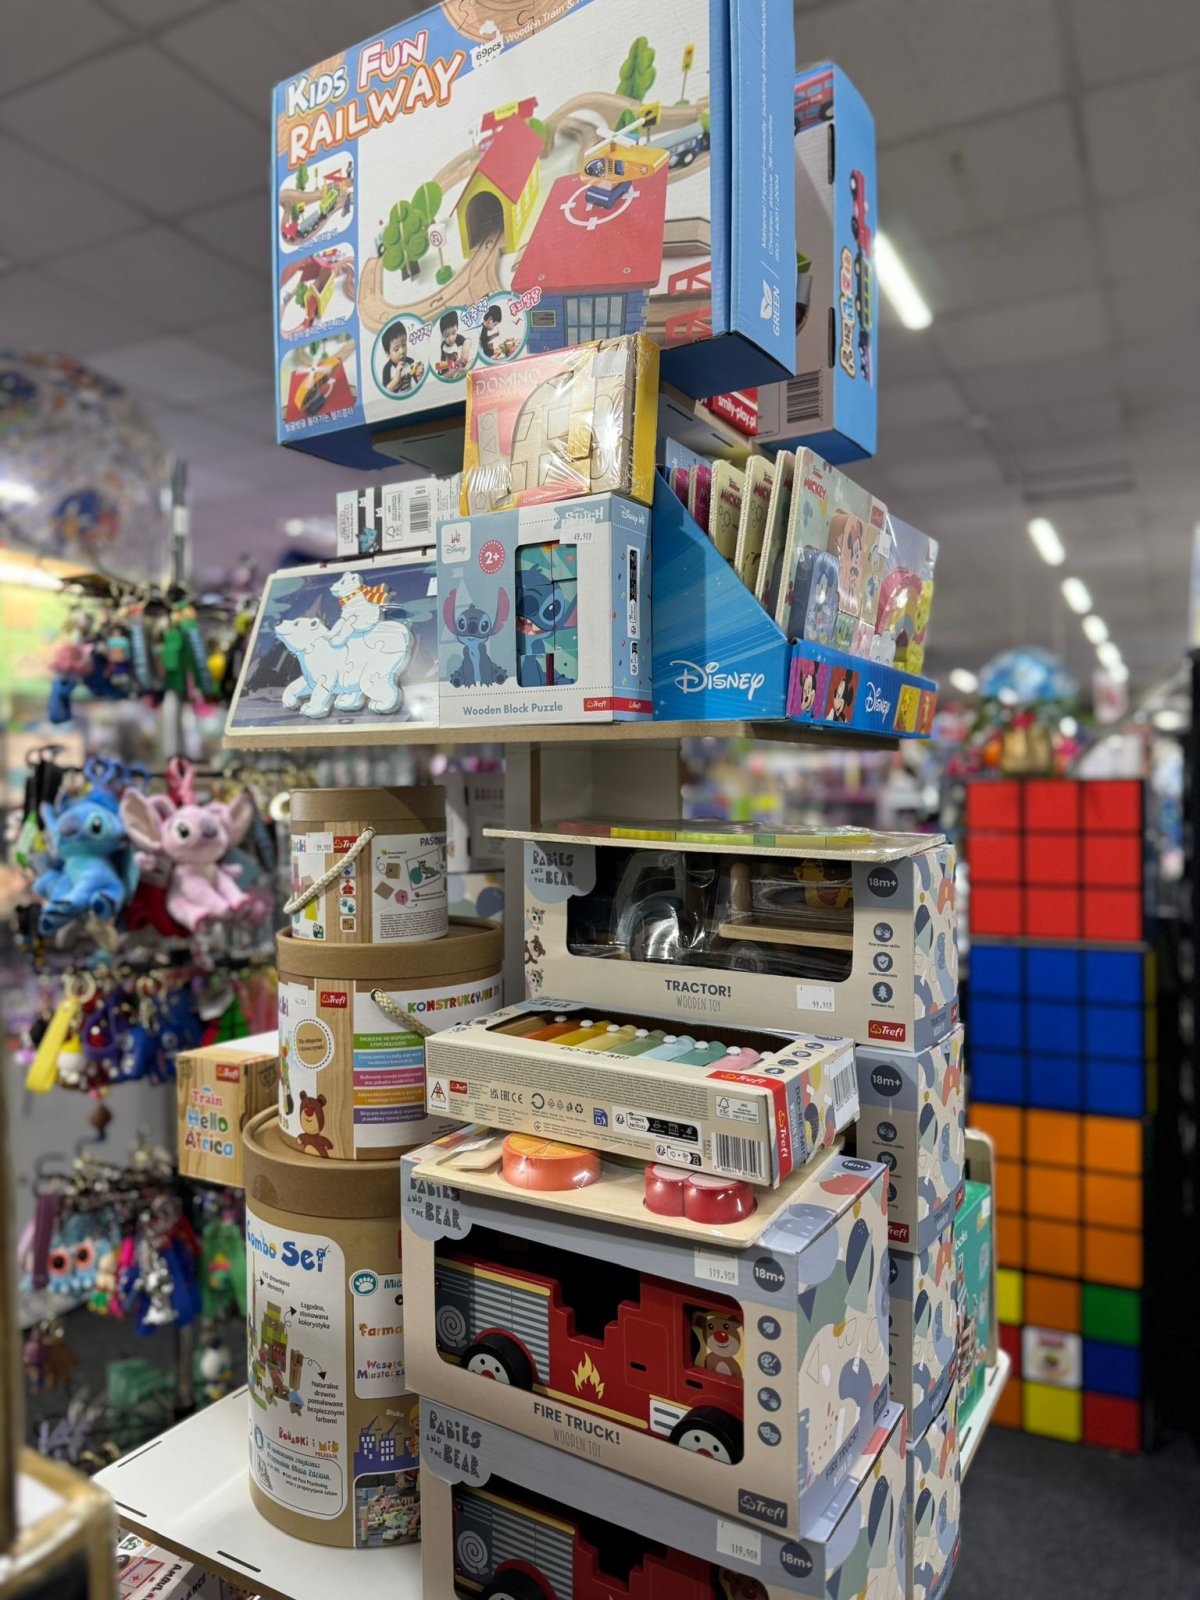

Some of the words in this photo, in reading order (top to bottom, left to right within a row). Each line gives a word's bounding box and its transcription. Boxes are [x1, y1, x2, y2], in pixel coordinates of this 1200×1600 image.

[476, 43, 502, 60] 69pcs
[505, 19, 541, 44] Wooden
[543, 6, 565, 22] Train
[286, 67, 348, 118] KIDS
[358, 30, 428, 90] FUN
[288, 50, 466, 169] RAILWAY
[772, 286, 781, 336] GREEN
[475, 368, 542, 395] DOMINO
[485, 551, 500, 565] 2+
[463, 704, 502, 716] Wooden
[503, 703, 529, 714] Block
[531, 702, 564, 713] Puzzle
[532, 850, 574, 867] BABIES
[546, 871, 575, 887] BEAR
[869, 877, 897, 888] 18m+
[664, 979, 731, 998] TRACTOR!
[329, 995, 346, 1005] Trefl
[676, 995, 707, 1010] WOODEN
[709, 998, 721, 1013] TOY
[880, 1025, 904, 1037] Trefl
[736, 1074, 767, 1085] Trefl
[872, 1074, 902, 1086] 18m+
[192, 1091, 223, 1106] Train
[186, 1107, 229, 1132] Hello
[185, 1130, 235, 1158] Africa
[780, 1126, 788, 1157] Trefl
[844, 1161, 870, 1170] 18m+
[425, 1201, 462, 1231] BEAR
[281, 1240, 329, 1273] Set
[755, 1267, 785, 1282] 18m+
[311, 1381, 339, 1390] Naturalne
[314, 1390, 336, 1399] drewno
[307, 1406, 345, 1417] bezpiecznymi
[315, 1416, 338, 1424] farbami
[430, 1410, 482, 1449] BABIES
[533, 1402, 562, 1423] FIRE
[564, 1413, 621, 1445] TRUCK!
[426, 1434, 442, 1444] AND
[553, 1427, 587, 1452] WOODEN
[588, 1441, 602, 1458] TOY
[430, 1447, 442, 1459] THE
[443, 1444, 480, 1478] BEAR
[755, 1500, 786, 1521] Trefl
[781, 1551, 813, 1569] 18m+
